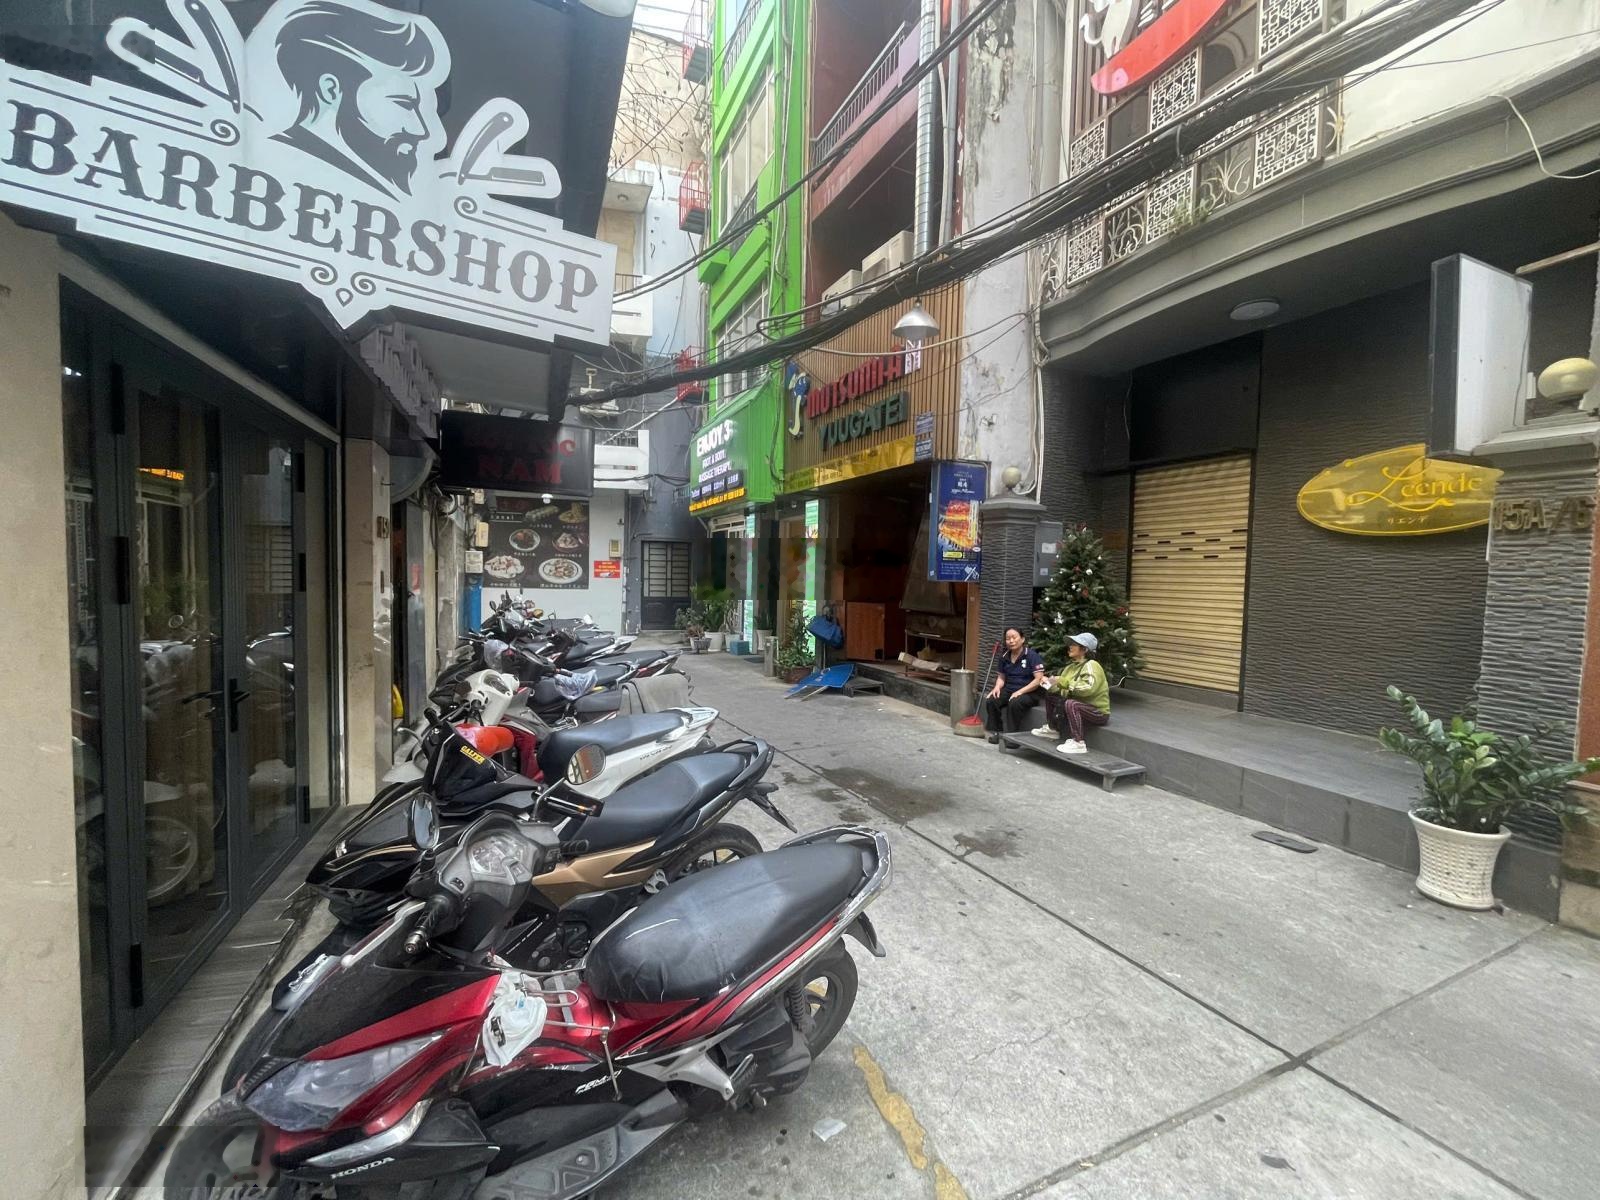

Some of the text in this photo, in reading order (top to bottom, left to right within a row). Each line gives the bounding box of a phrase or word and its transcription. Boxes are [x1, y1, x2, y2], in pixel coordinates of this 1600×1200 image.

[1, 99, 598, 313] BARBERSHOP
[697, 424, 724, 457] ENJOY
[819, 390, 909, 450] YUUGATEI
[330, 1157, 395, 1179] HONDA
